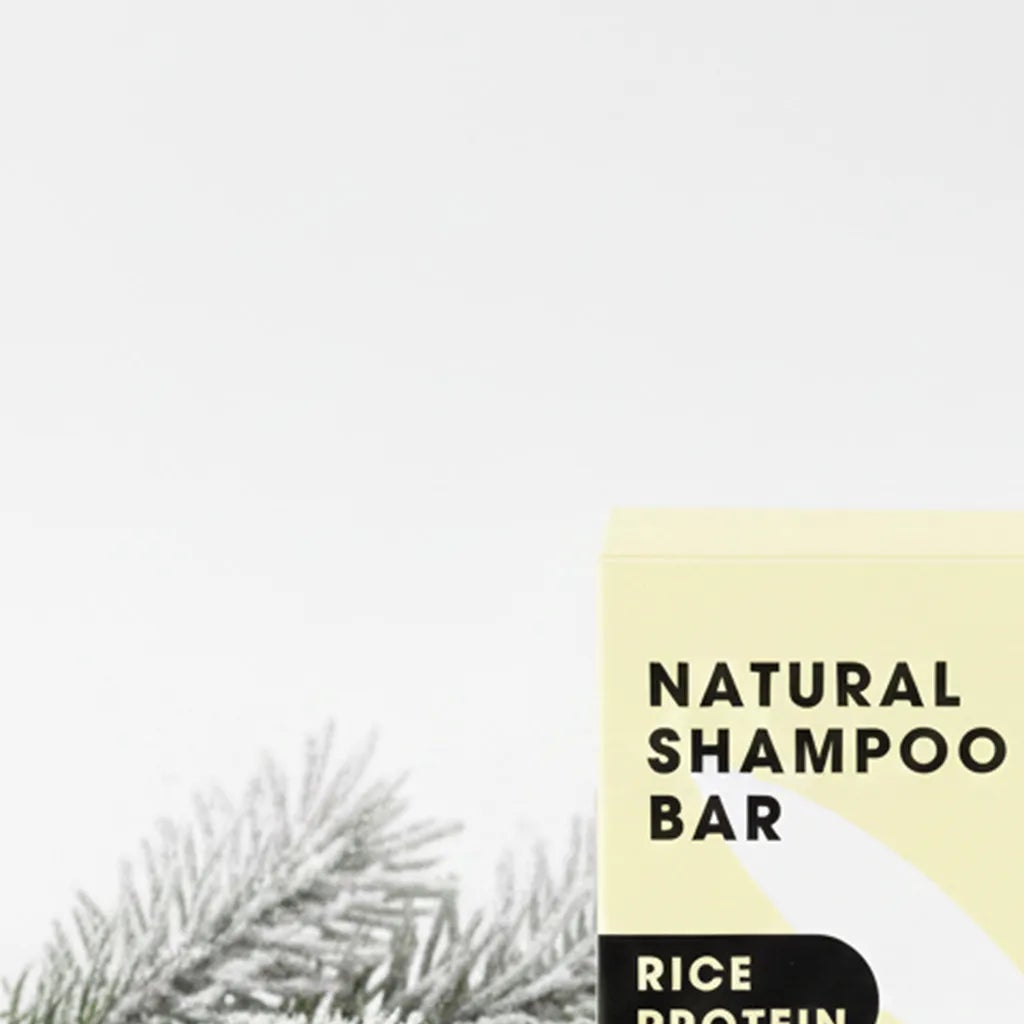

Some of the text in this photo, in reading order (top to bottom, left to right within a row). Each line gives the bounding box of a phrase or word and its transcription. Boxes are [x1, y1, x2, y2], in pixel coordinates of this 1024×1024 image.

[648, 661, 962, 709] NATURAL
[647, 727, 1008, 774] SHAMPOO
[649, 794, 783, 842] BAR
[636, 955, 752, 992] RICE
